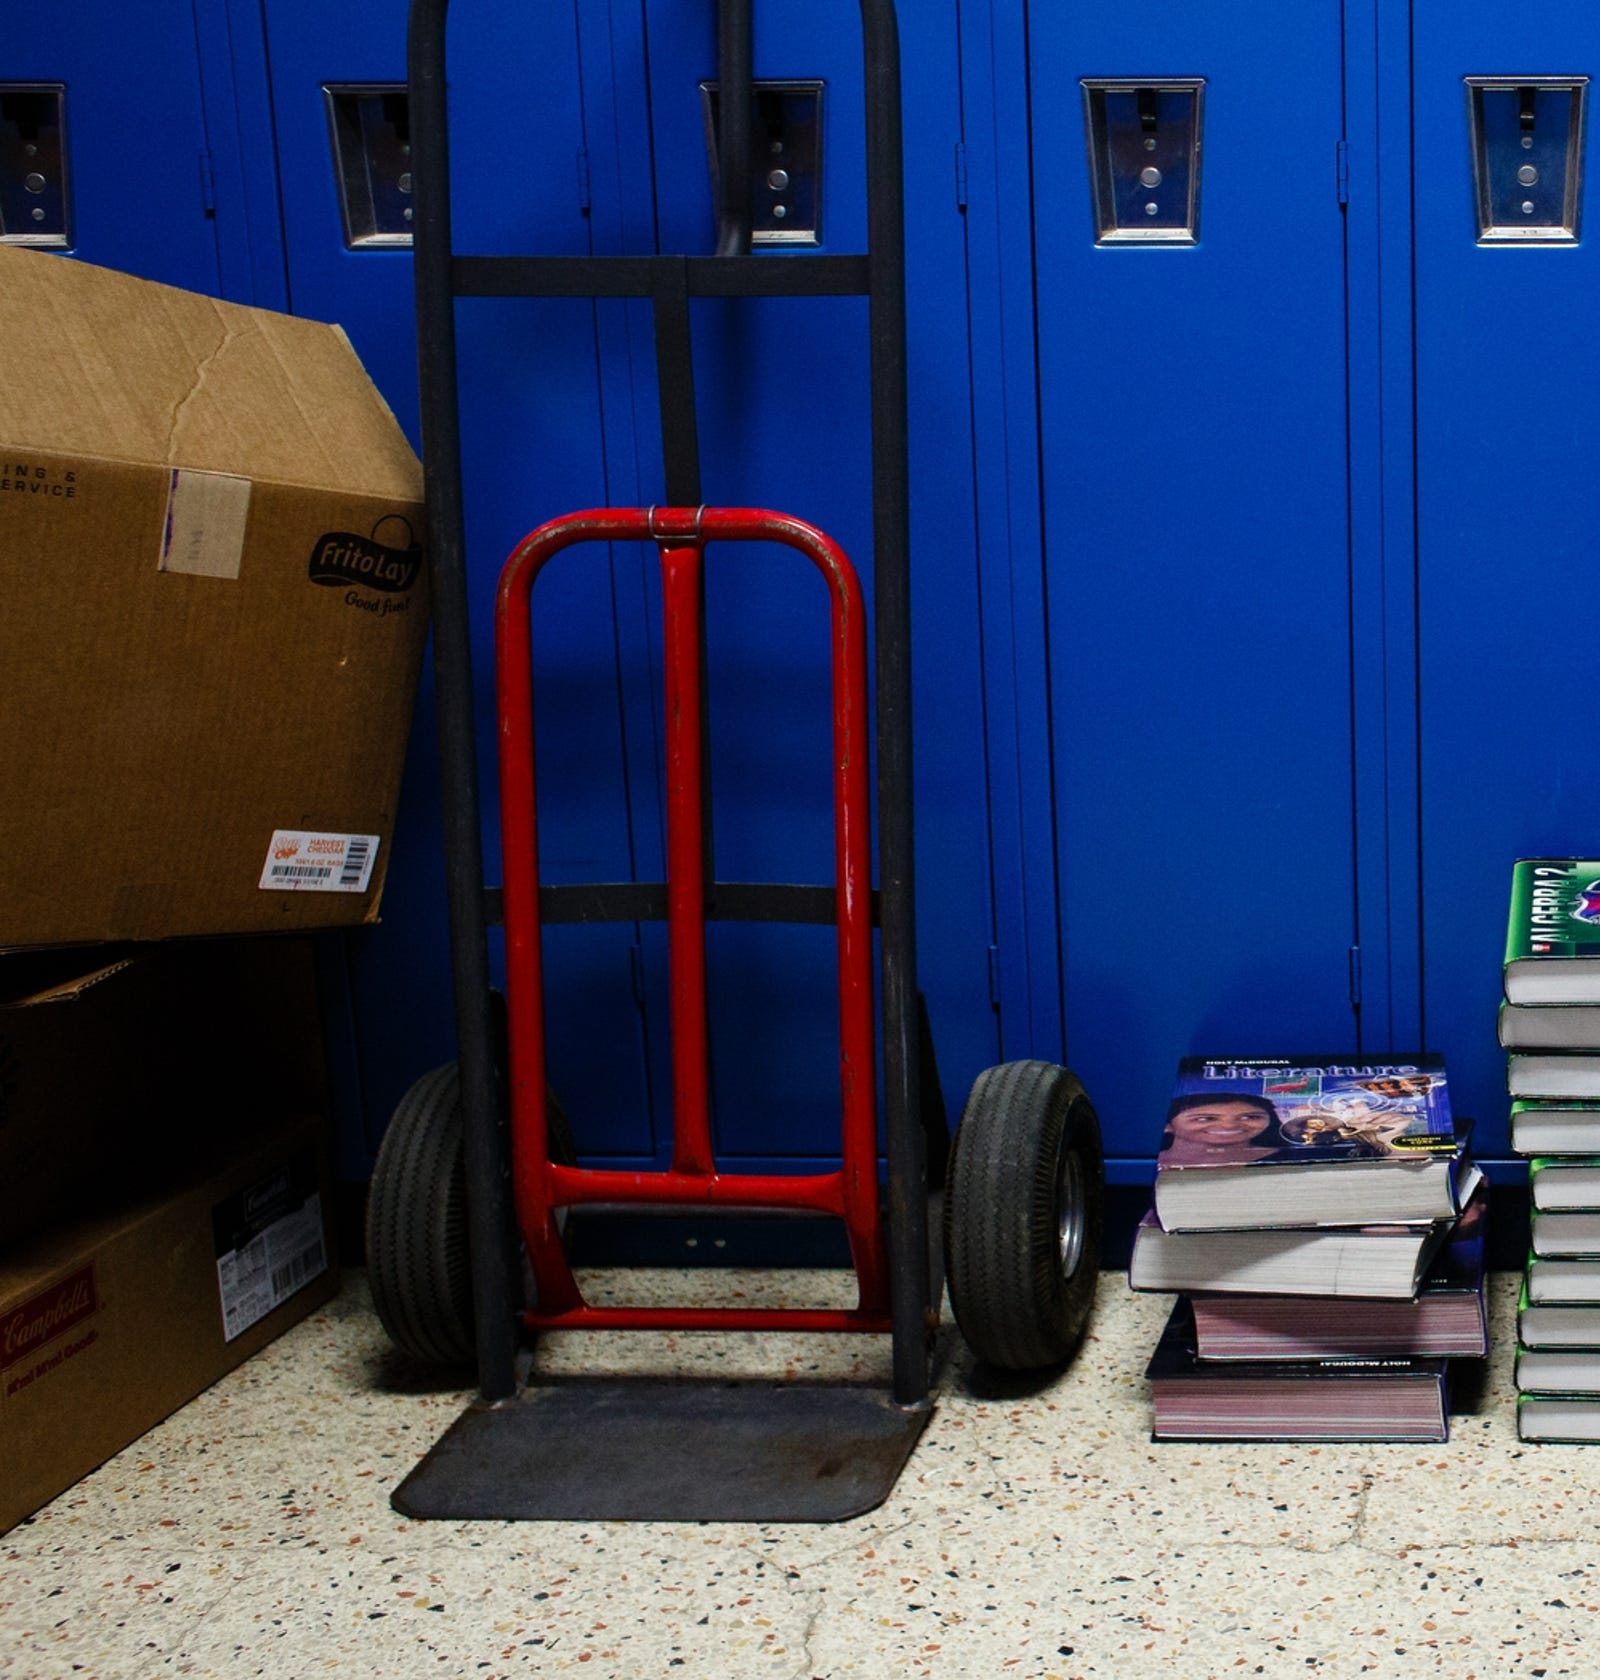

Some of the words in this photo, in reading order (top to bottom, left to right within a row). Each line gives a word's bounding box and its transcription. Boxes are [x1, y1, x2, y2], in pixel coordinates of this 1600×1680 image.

[345, 591, 380, 614] Good
[1530, 879, 1568, 943] ALGEBRA
[1203, 1064, 1418, 1080] Literature
